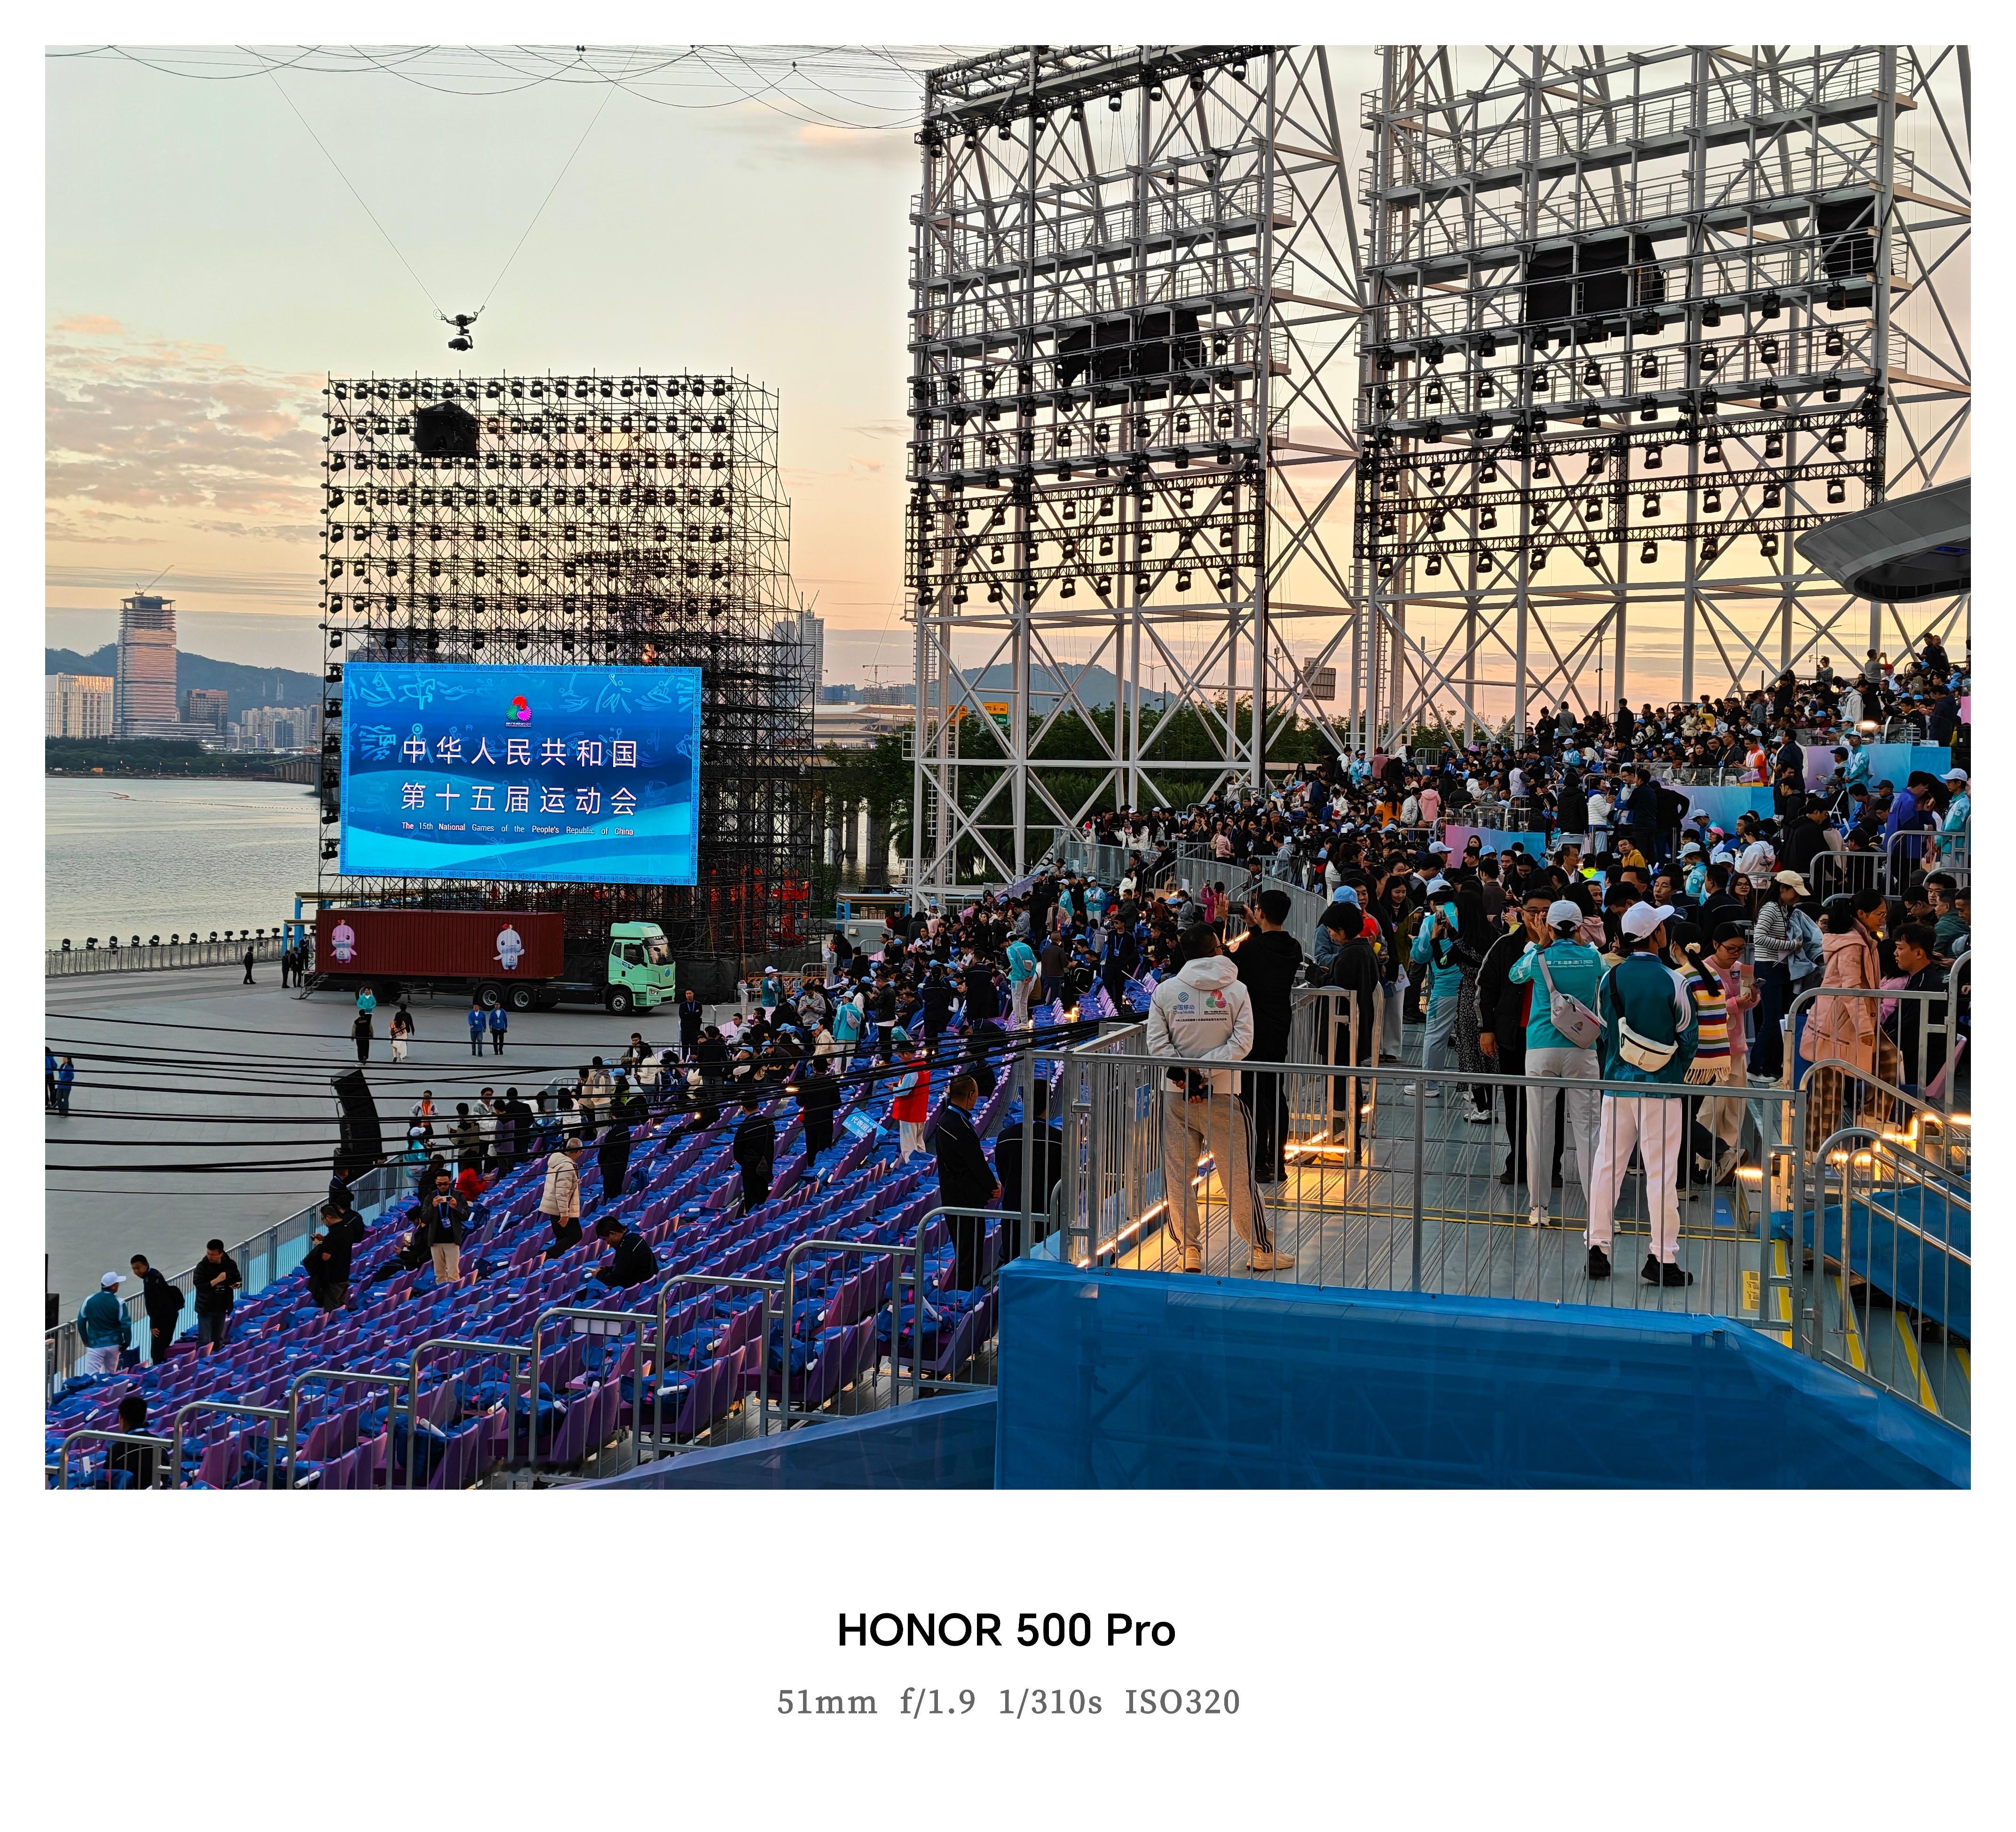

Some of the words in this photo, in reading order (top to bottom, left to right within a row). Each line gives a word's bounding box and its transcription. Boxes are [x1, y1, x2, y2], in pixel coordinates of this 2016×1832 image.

[403, 736, 636, 767] 中华人民共和国
[402, 782, 637, 815] 第十五届运动会
[532, 825, 559, 834] People's
[566, 826, 595, 835] Republic
[614, 827, 634, 836] China
[851, 1116, 869, 1131] 代表团
